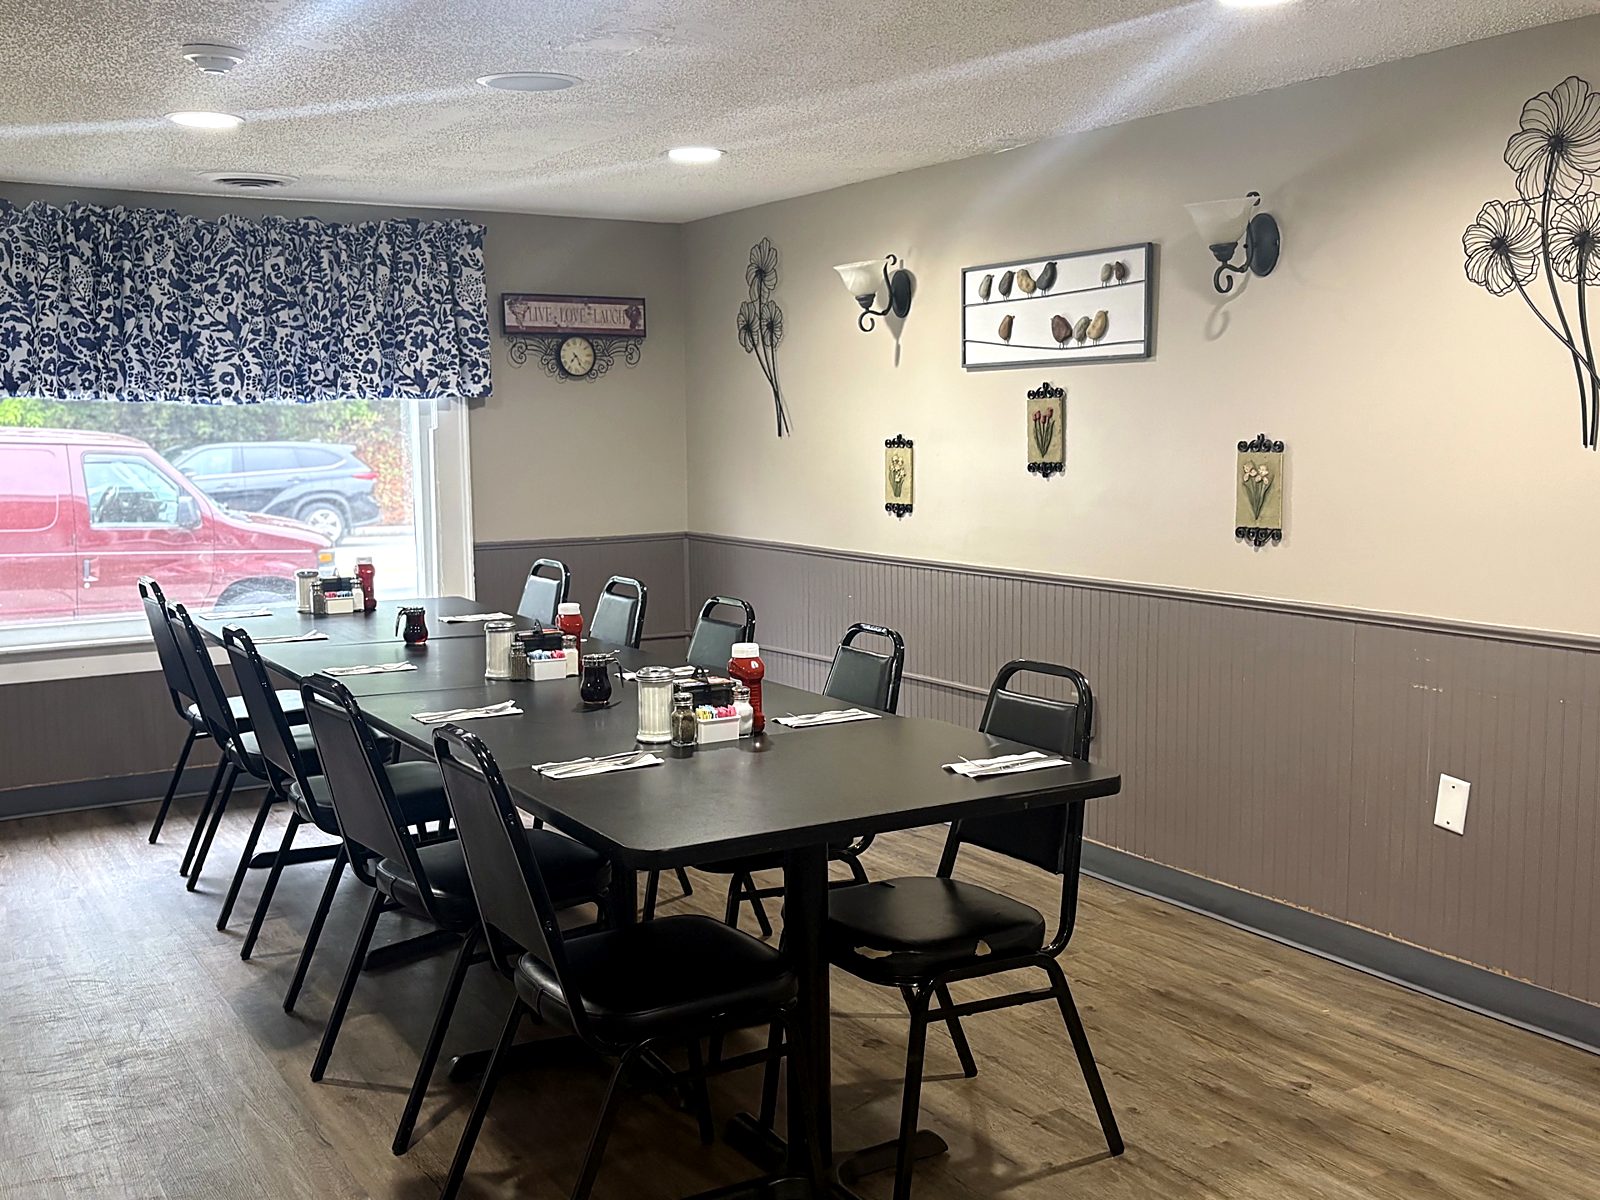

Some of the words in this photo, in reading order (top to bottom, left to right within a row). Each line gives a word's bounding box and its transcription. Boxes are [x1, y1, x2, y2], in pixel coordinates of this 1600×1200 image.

[529, 306, 552, 322] LIVE
[559, 306, 585, 323] LOVE
[593, 307, 627, 325] LAUGH
